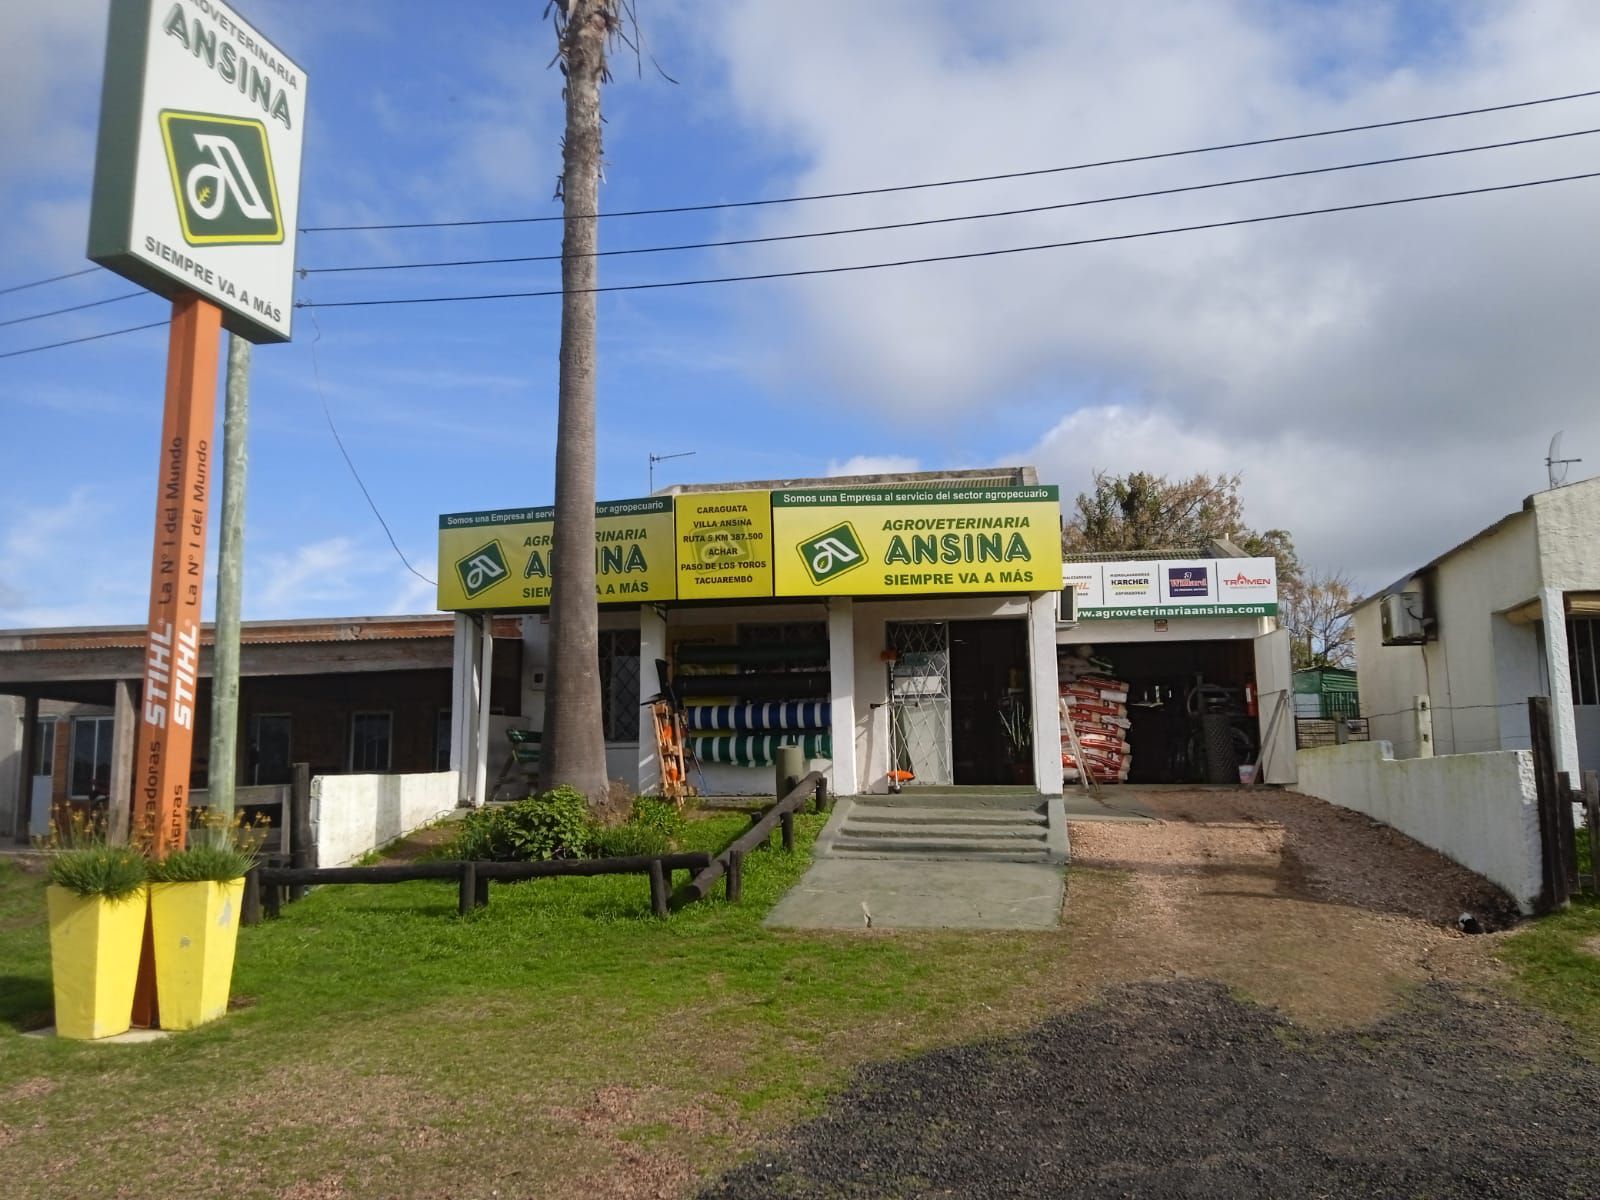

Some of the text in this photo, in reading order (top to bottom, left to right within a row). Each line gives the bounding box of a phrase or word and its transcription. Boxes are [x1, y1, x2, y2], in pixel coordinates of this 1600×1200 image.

[162, 2, 291, 130] ANSINA
[145, 236, 281, 323] SIEMPRE VA A MÁS
[166, 437, 183, 500] Mundo
[193, 439, 208, 502] Mundo
[783, 489, 1048, 504] Somos una Empresa al servicio del sector agropecuario
[163, 508, 177, 534] del
[447, 516, 473, 525] Somos
[475, 515, 490, 523] una
[491, 513, 525, 523] Empresa
[526, 511, 534, 520] al
[609, 500, 664, 514] agropecuario
[697, 504, 748, 514] CARAGUATA
[191, 509, 203, 536] del
[693, 518, 752, 529] VILLA ANSINA
[882, 516, 1030, 531] AGROVETERINARIA
[683, 535, 706, 543] RUTA
[715, 533, 728, 541] KM
[884, 532, 1032, 565] ANSINA
[709, 547, 738, 556] ACHAR
[681, 560, 767, 571] PASO DE LOS TOROS
[884, 569, 1034, 586] SIEMPRE VA A MÁS
[158, 582, 173, 606] La
[185, 584, 198, 607] La
[606, 584, 615, 594] A
[619, 579, 649, 594] MÁS
[145, 623, 172, 729] STIHL
[173, 625, 197, 730] STIHL
